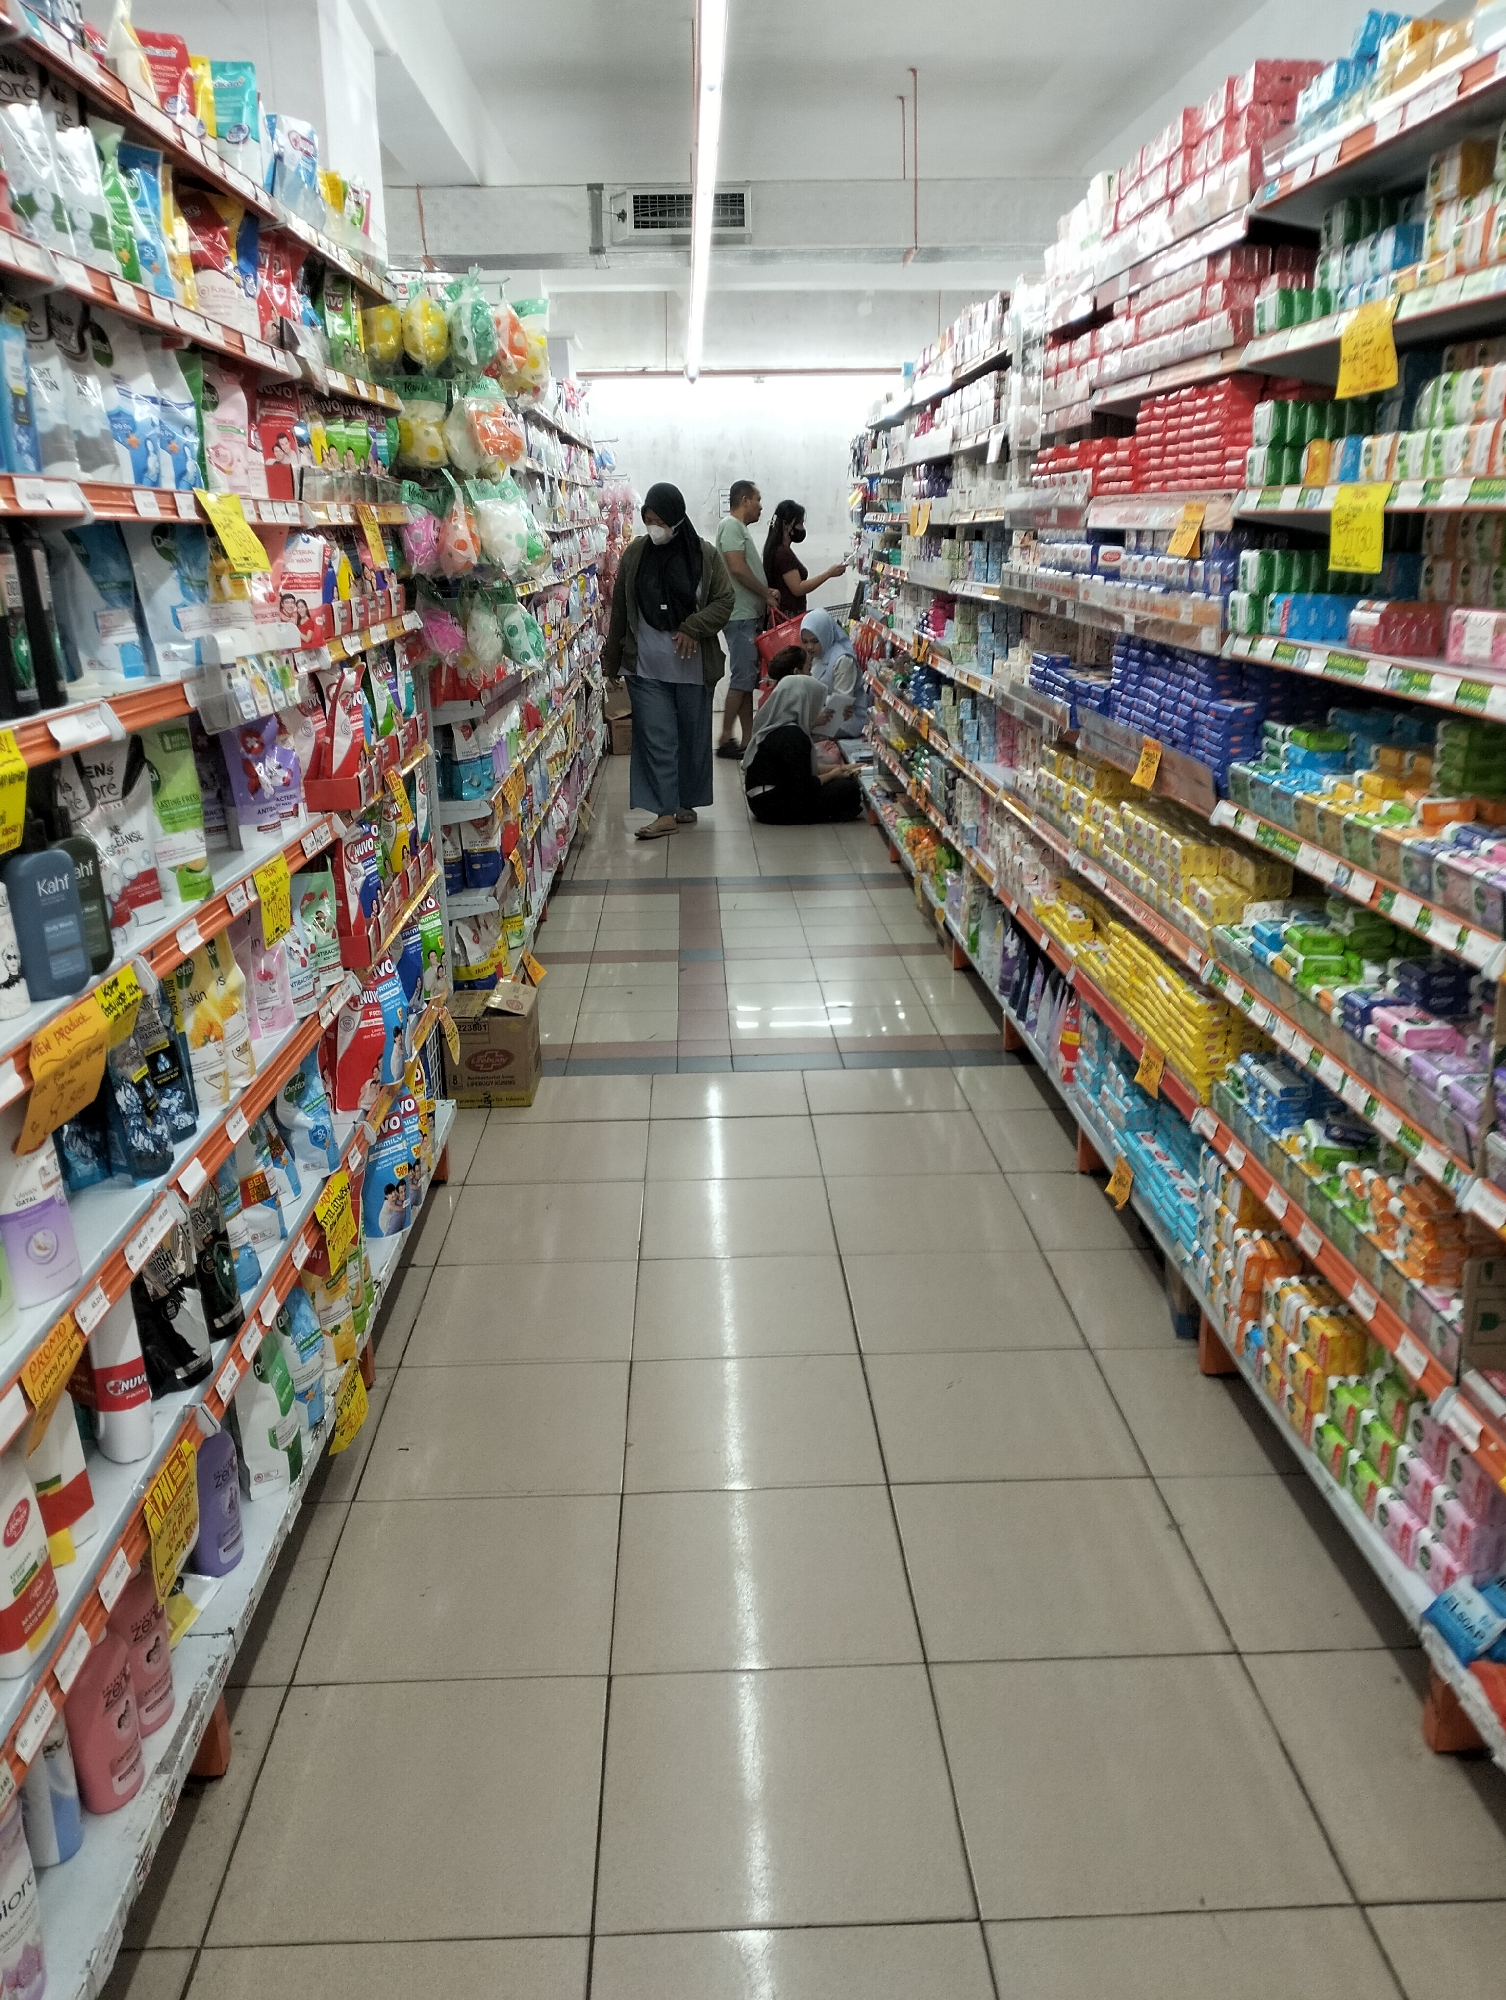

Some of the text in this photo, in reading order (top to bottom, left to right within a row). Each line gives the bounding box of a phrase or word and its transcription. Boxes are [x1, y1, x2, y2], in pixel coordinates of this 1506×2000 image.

[325, 294, 344, 308] UVO
[287, 549, 316, 557] ACTERIAL
[354, 837, 374, 859] NUVO
[74, 860, 95, 880] ahf
[36, 873, 71, 897] Kahf
[164, 979, 175, 996] BIG
[470, 1056, 509, 1067] Lifebuoy
[452, 1074, 458, 1086] 8
[374, 1134, 404, 1150] FAMILY
[15, 1196, 38, 1208] GATAL
[28, 1322, 67, 1383] PROMO
